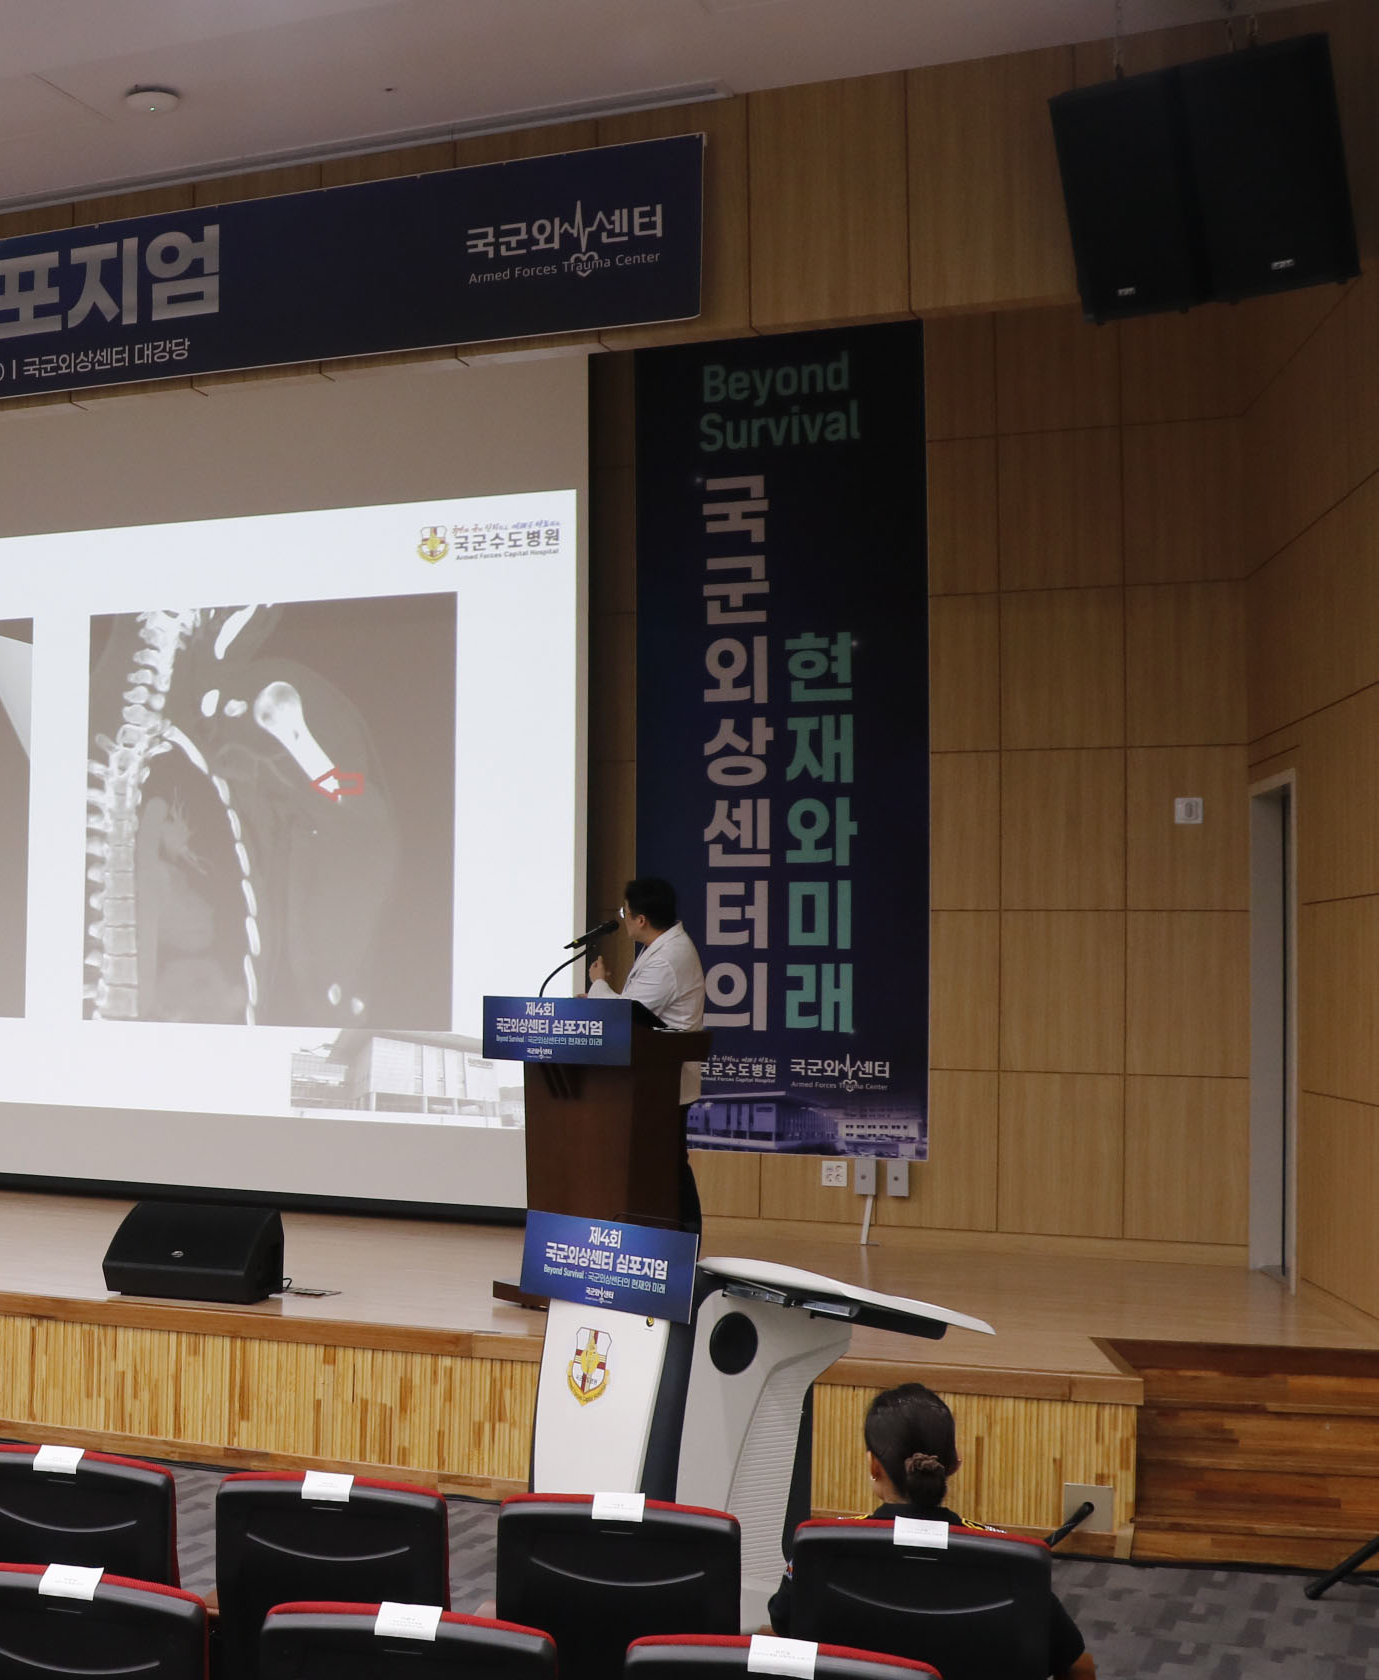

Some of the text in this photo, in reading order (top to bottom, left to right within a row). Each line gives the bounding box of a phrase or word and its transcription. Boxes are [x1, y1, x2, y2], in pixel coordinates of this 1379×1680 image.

[468, 252, 661, 284] Armed Forces Trauma Center
[23, 347, 130, 379] 국군외상센터
[133, 337, 191, 366] 대강당
[703, 350, 850, 406] Beyond
[699, 399, 861, 451] Survival
[454, 528, 560, 552] 국군수도병원
[503, 550, 528, 558] Capital
[525, 1001, 554, 1017] 제4회
[496, 1017, 603, 1036] 국군외상센터 심포지엄
[700, 1060, 777, 1078] 국군수도병원
[791, 1081, 814, 1089] Armed
[815, 1081, 837, 1090] Forces
[865, 1083, 889, 1092] Center
[589, 1226, 622, 1249] 제4회
[546, 1242, 668, 1281] 국군외상센터 심포지엄
[543, 1263, 563, 1276] Beyond
[588, 1271, 630, 1288] 국군외상센터의
